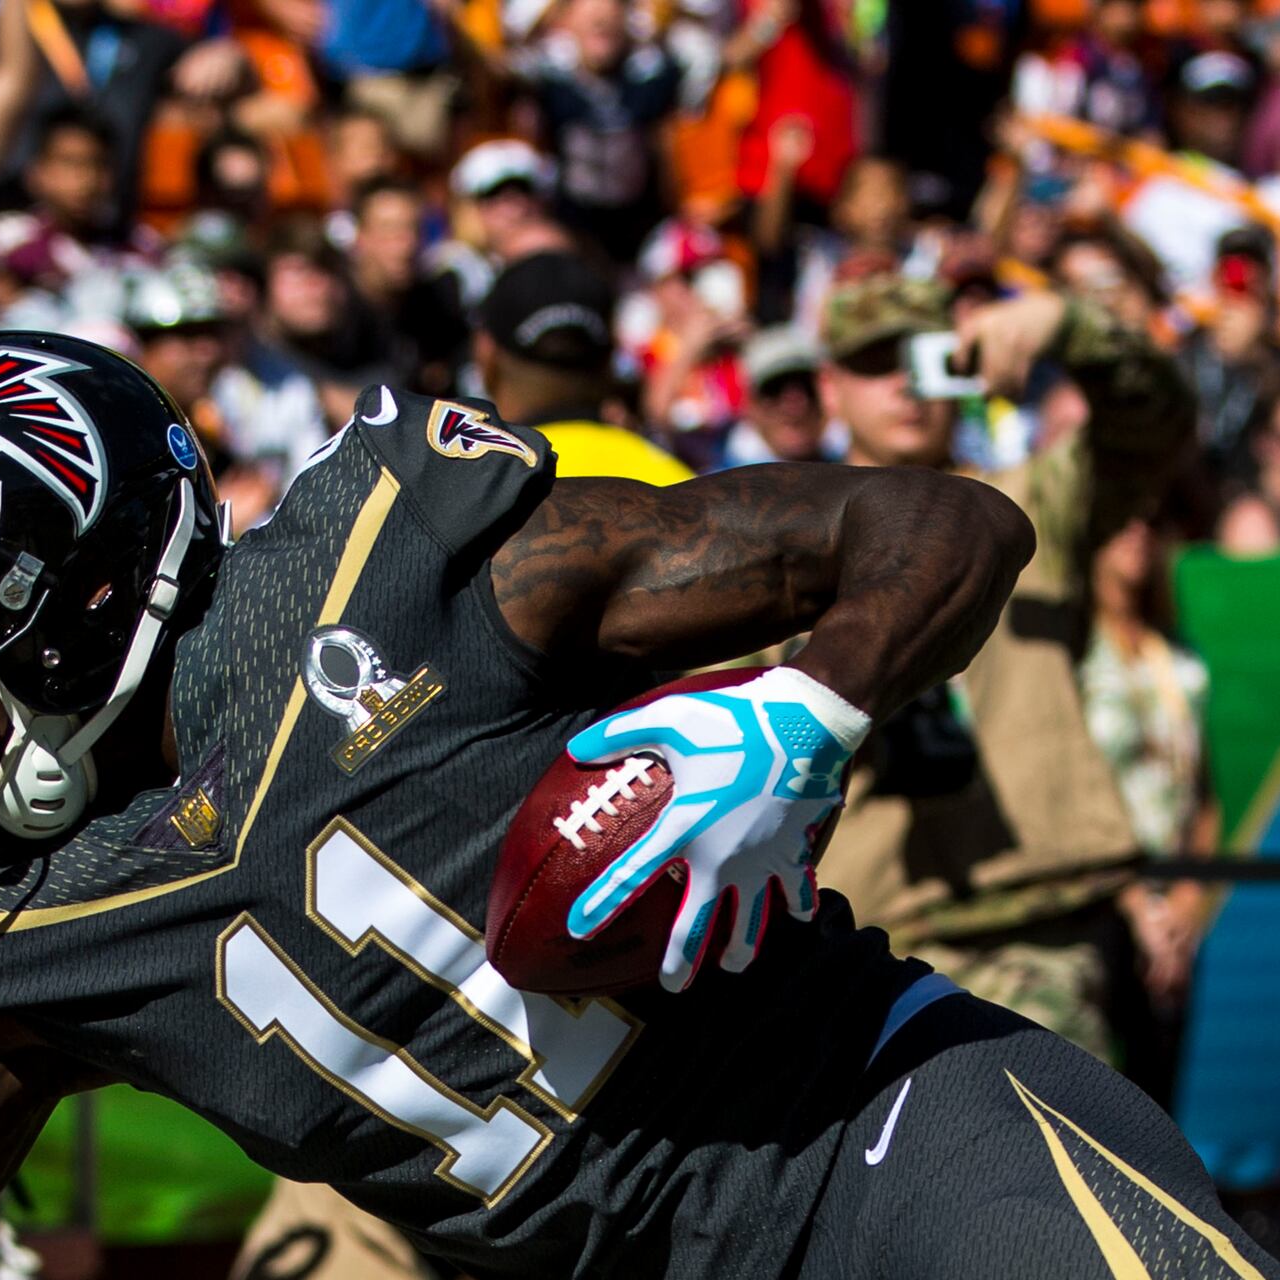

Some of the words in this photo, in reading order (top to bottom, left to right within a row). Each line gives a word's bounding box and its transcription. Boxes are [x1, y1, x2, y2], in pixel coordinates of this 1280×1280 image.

[343, 723, 384, 760] PRO
[380, 677, 436, 726] BOWL
[216, 814, 647, 1210] 11
